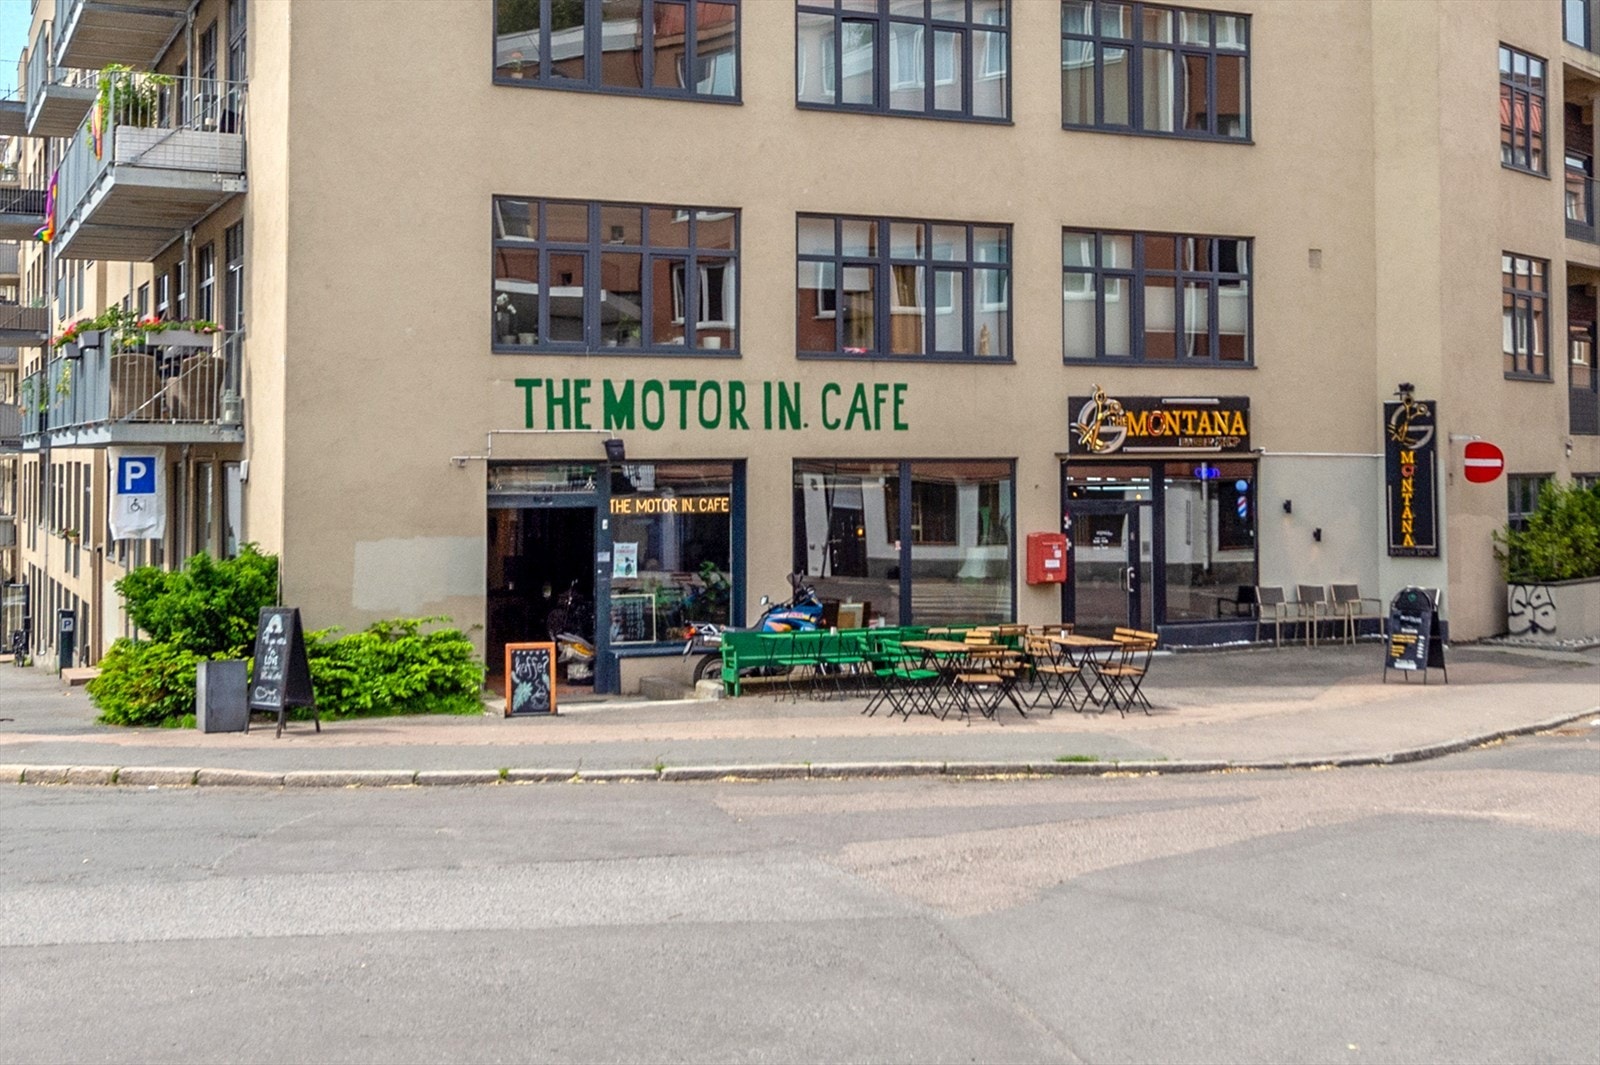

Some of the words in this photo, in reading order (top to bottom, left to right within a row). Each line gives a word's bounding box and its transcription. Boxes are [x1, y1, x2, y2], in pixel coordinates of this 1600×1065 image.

[514, 378, 591, 430] THE
[602, 378, 750, 431] MOTOR
[763, 380, 809, 430] IN.
[821, 382, 909, 431] CAFE
[1126, 409, 1247, 437] MONTANA
[125, 461, 147, 490] P
[610, 497, 631, 514] THE
[635, 497, 677, 513] MOTOR
[681, 497, 695, 513] IN.
[698, 497, 729, 513] CAFE
[1400, 450, 1416, 547] MONTANA
[63, 620, 71, 630] P
